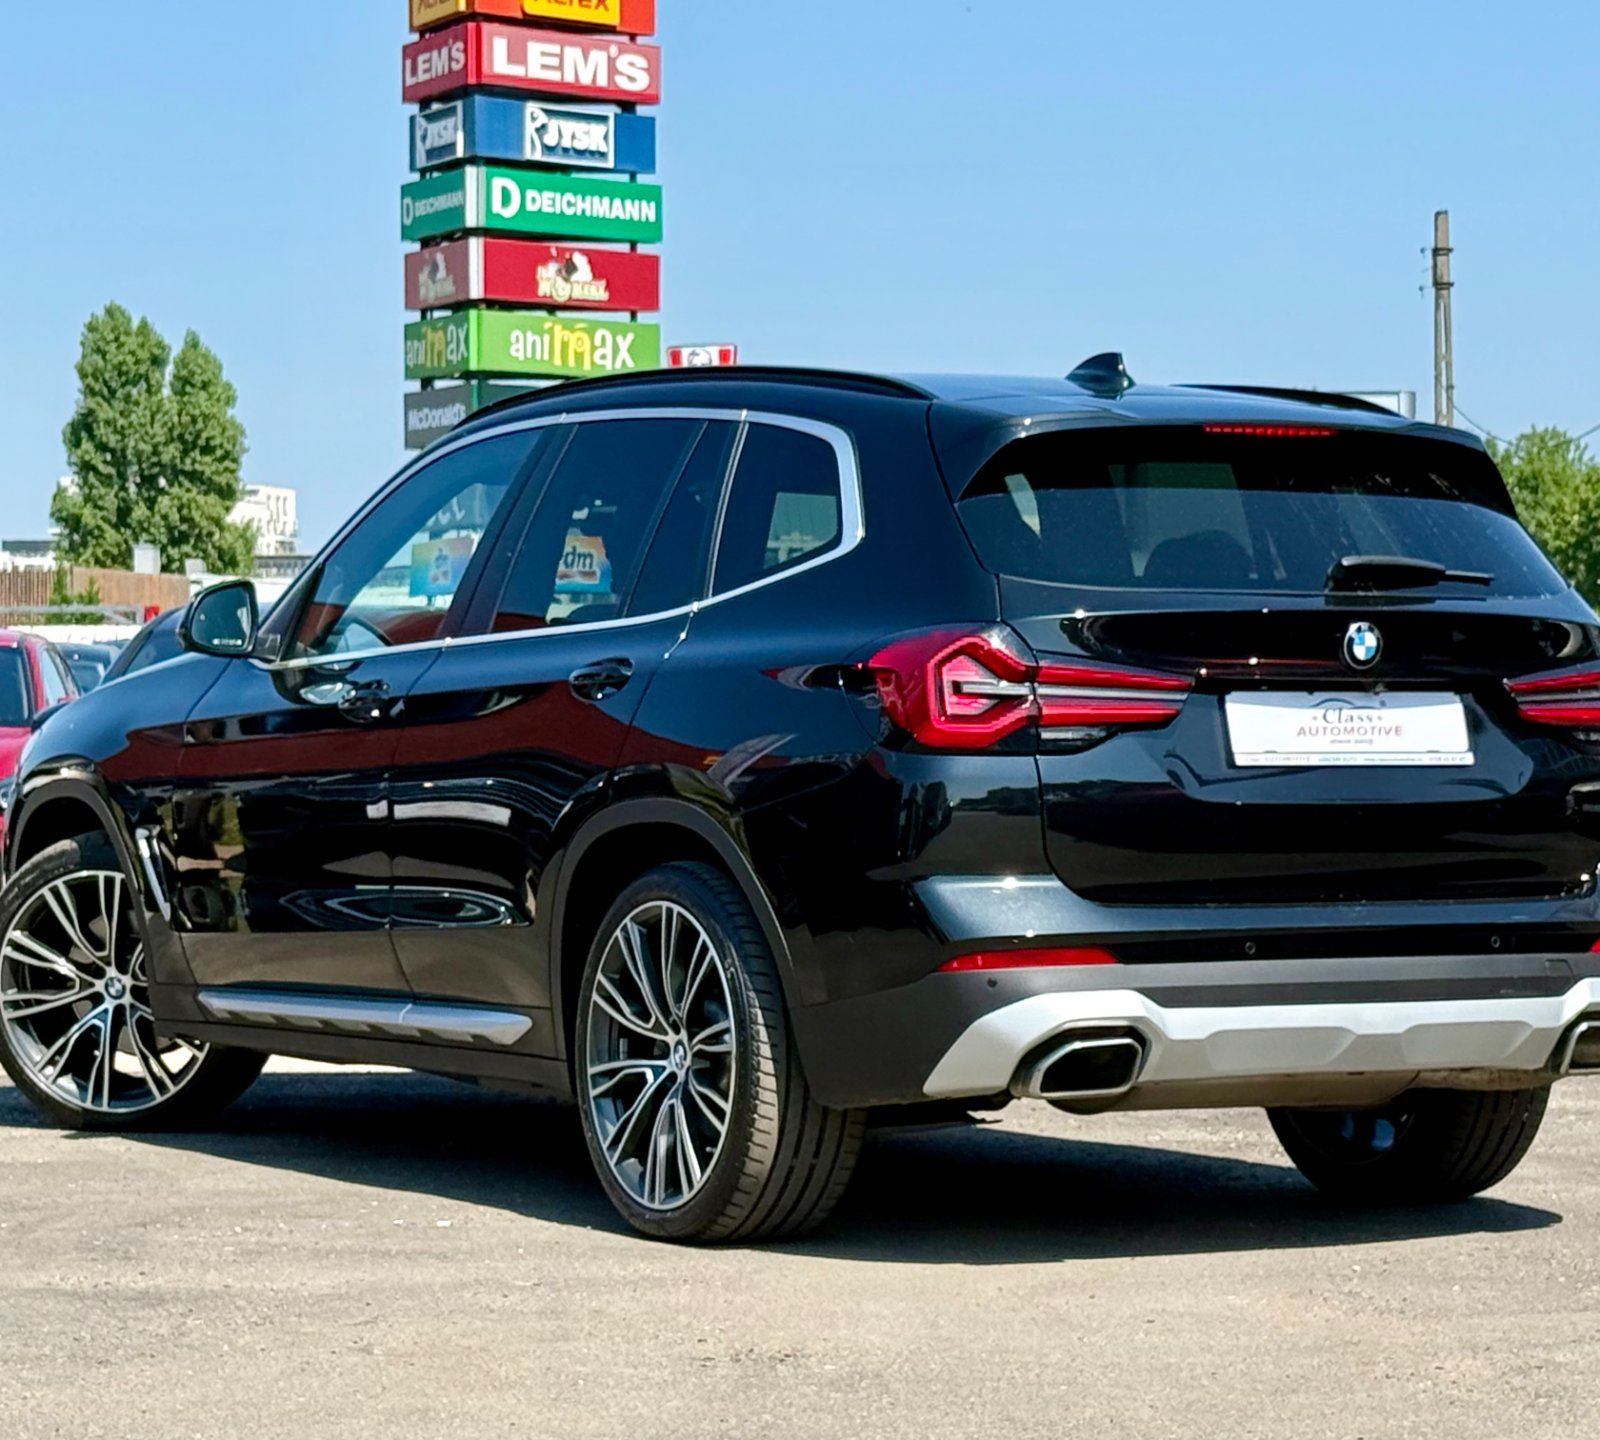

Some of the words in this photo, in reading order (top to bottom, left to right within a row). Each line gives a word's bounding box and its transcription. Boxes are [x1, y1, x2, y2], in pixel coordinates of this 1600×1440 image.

[404, 39, 465, 87] LEM'S
[492, 36, 650, 91] LEM'S
[543, 120, 608, 153] JYSK
[525, 189, 656, 222] DEICHMANN
[510, 322, 635, 371] animax
[563, 545, 594, 570] dm
[1296, 726, 1403, 737] AUTOMOTIVE
[1322, 707, 1374, 724] Class
